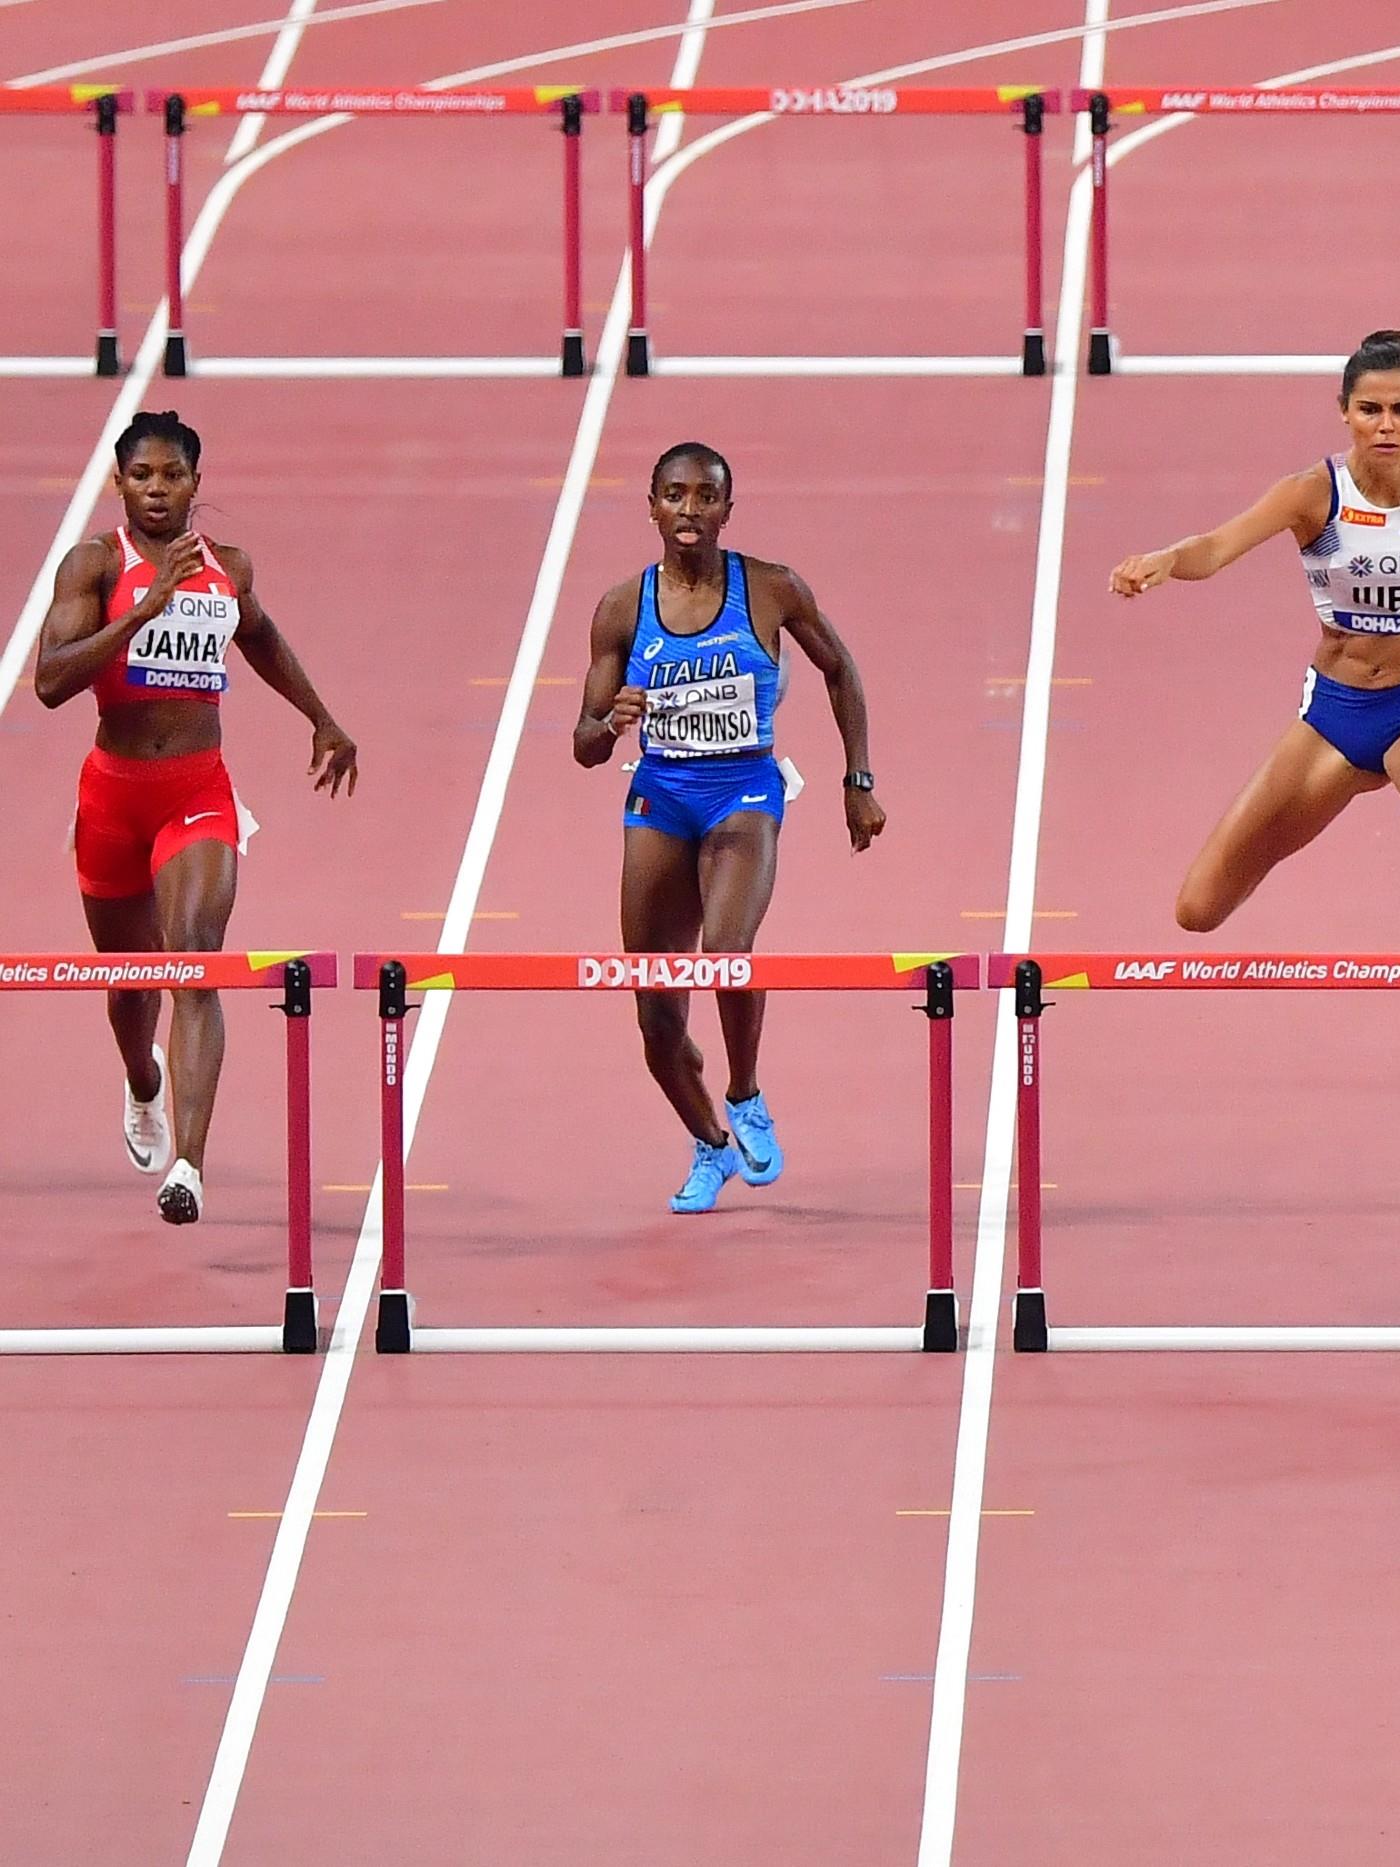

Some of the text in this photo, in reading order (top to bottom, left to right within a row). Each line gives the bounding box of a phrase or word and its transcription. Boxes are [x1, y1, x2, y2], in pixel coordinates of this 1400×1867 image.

[770, 88, 897, 113] DOHA2019
[180, 597, 227, 618] QNB
[145, 671, 222, 690] DOHA2019
[650, 653, 738, 687] ITALIA
[53, 961, 205, 985] Championships
[578, 957, 751, 987] DOHA2019
[1114, 961, 1177, 980] IAAF
[1181, 961, 1238, 980] World
[1243, 960, 1328, 980] Athletics
